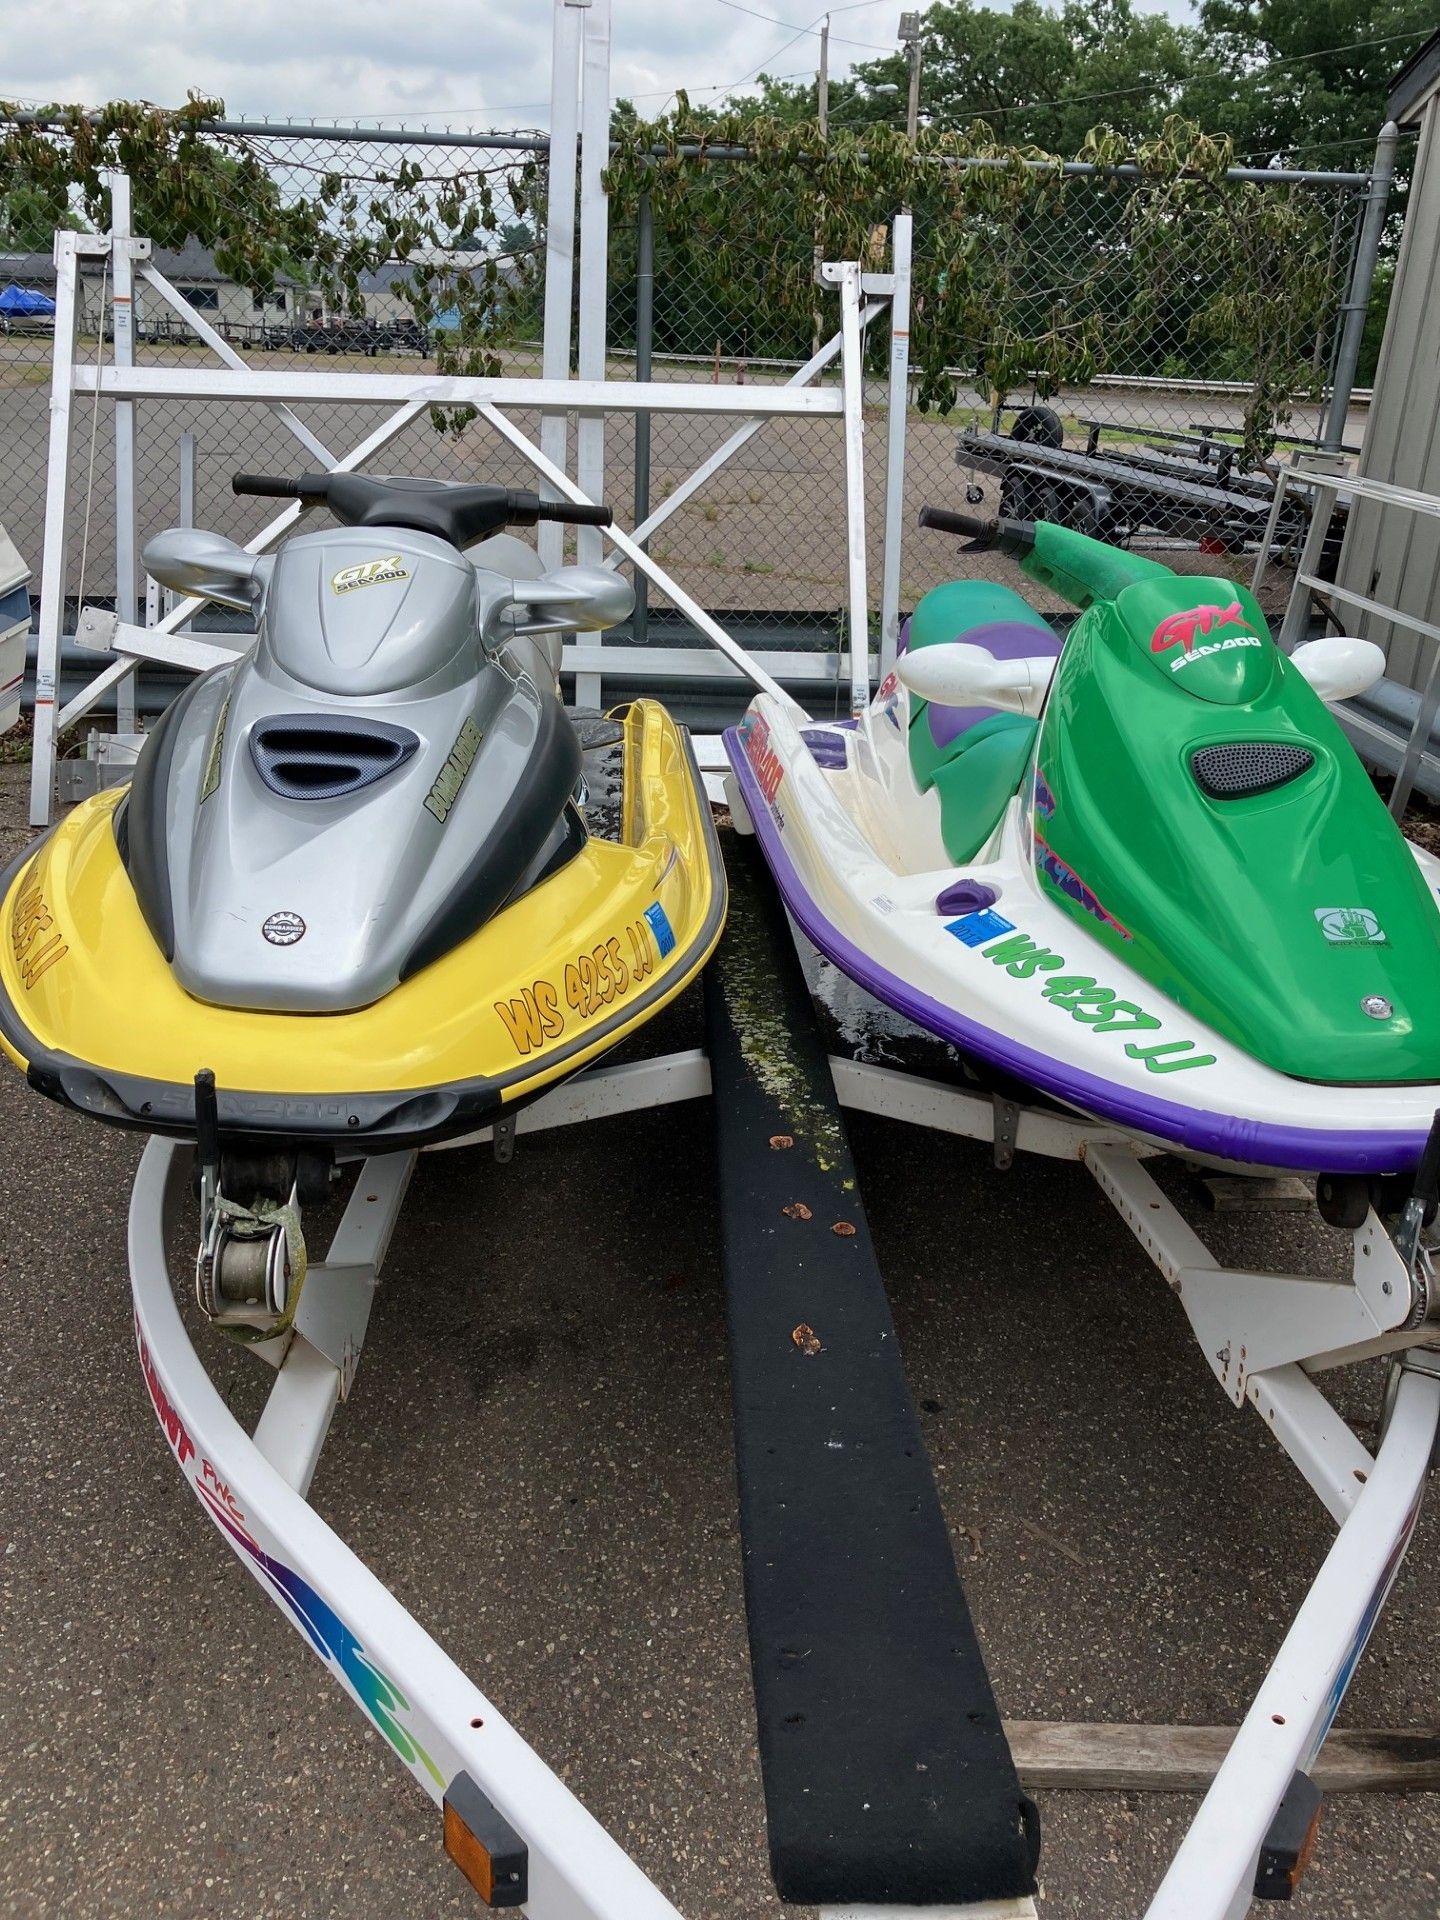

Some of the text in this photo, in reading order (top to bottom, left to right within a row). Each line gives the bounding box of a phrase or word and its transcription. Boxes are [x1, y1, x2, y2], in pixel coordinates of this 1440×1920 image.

[332, 556, 402, 584] GTX
[1151, 601, 1260, 654] GTX
[423, 715, 484, 824] BOMBARDIER
[493, 920, 654, 1055] WS 4255 JJ
[981, 933, 1217, 1074] WS 4257 JJ
[202, 1459, 245, 1521] PWC
